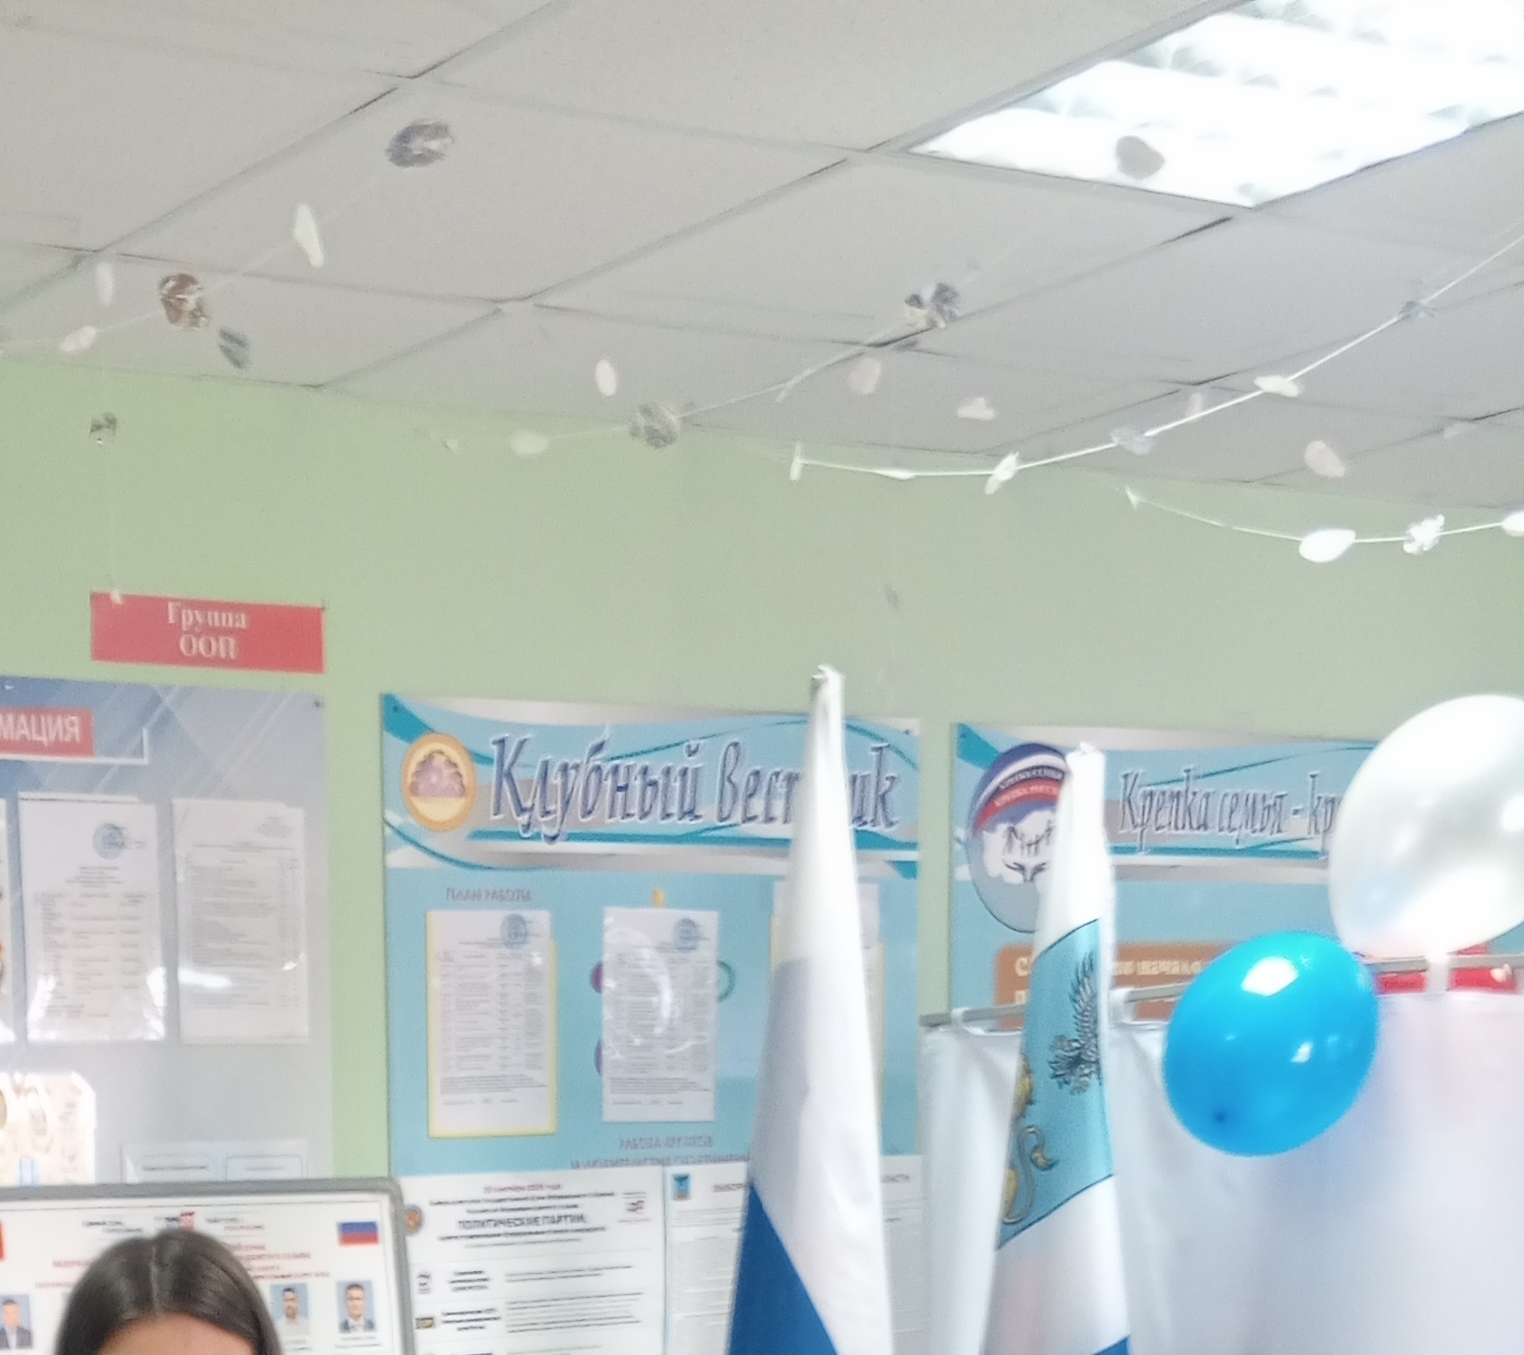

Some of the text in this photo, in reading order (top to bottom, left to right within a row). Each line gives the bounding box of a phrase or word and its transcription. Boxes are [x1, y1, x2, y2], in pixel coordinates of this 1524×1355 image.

[167, 601, 249, 632] Группа
[179, 633, 237, 659] ООП
[490, 724, 900, 844] Клубный Вестик
[1119, 765, 1214, 855] Крепка
[1217, 789, 1288, 846] семья
